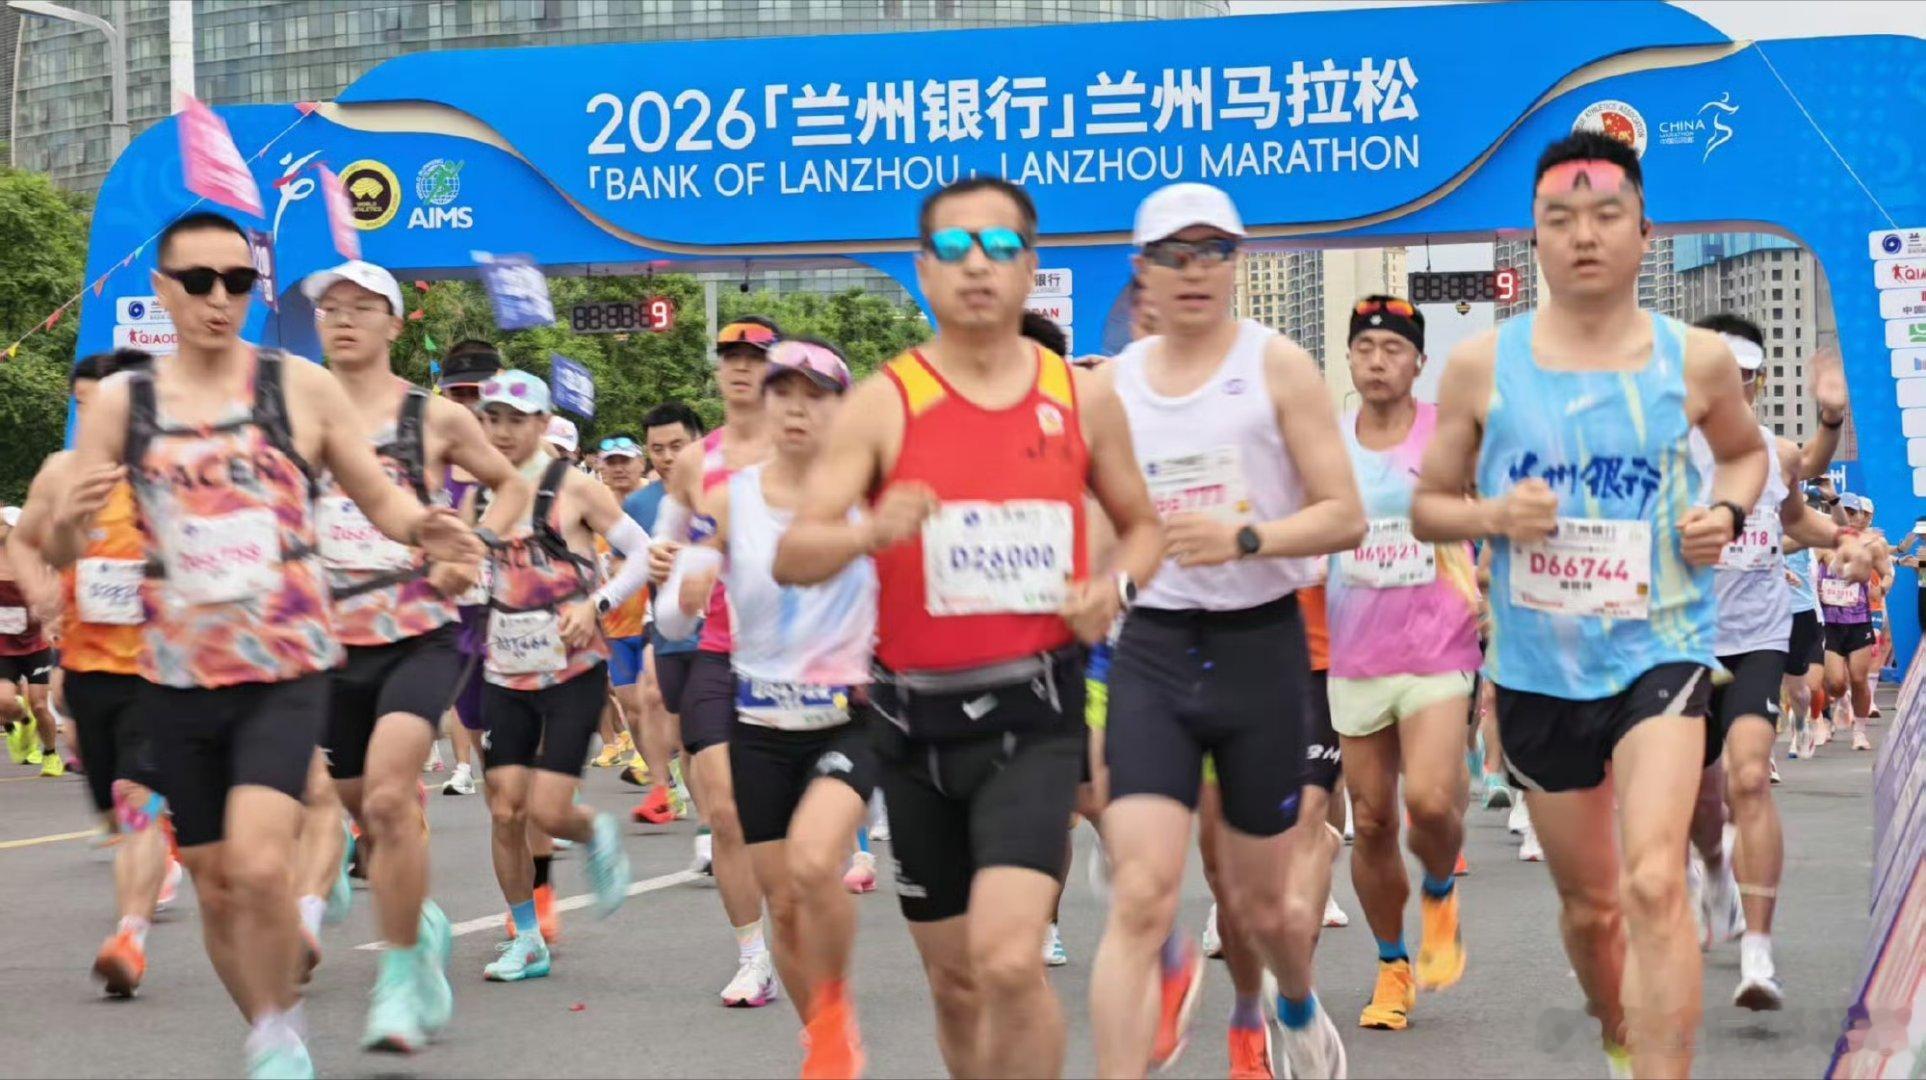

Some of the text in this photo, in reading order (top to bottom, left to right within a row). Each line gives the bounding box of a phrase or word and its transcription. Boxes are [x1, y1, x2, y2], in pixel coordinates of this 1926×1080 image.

[1659, 119, 1706, 133] CHINA
[714, 162, 765, 196] OF
[1001, 145, 1184, 185] LANZHOU
[1200, 134, 1419, 179] MARATHON
[407, 206, 474, 229] AIMS
[1733, 530, 1769, 546] 118
[1530, 552, 1629, 581] D66744
